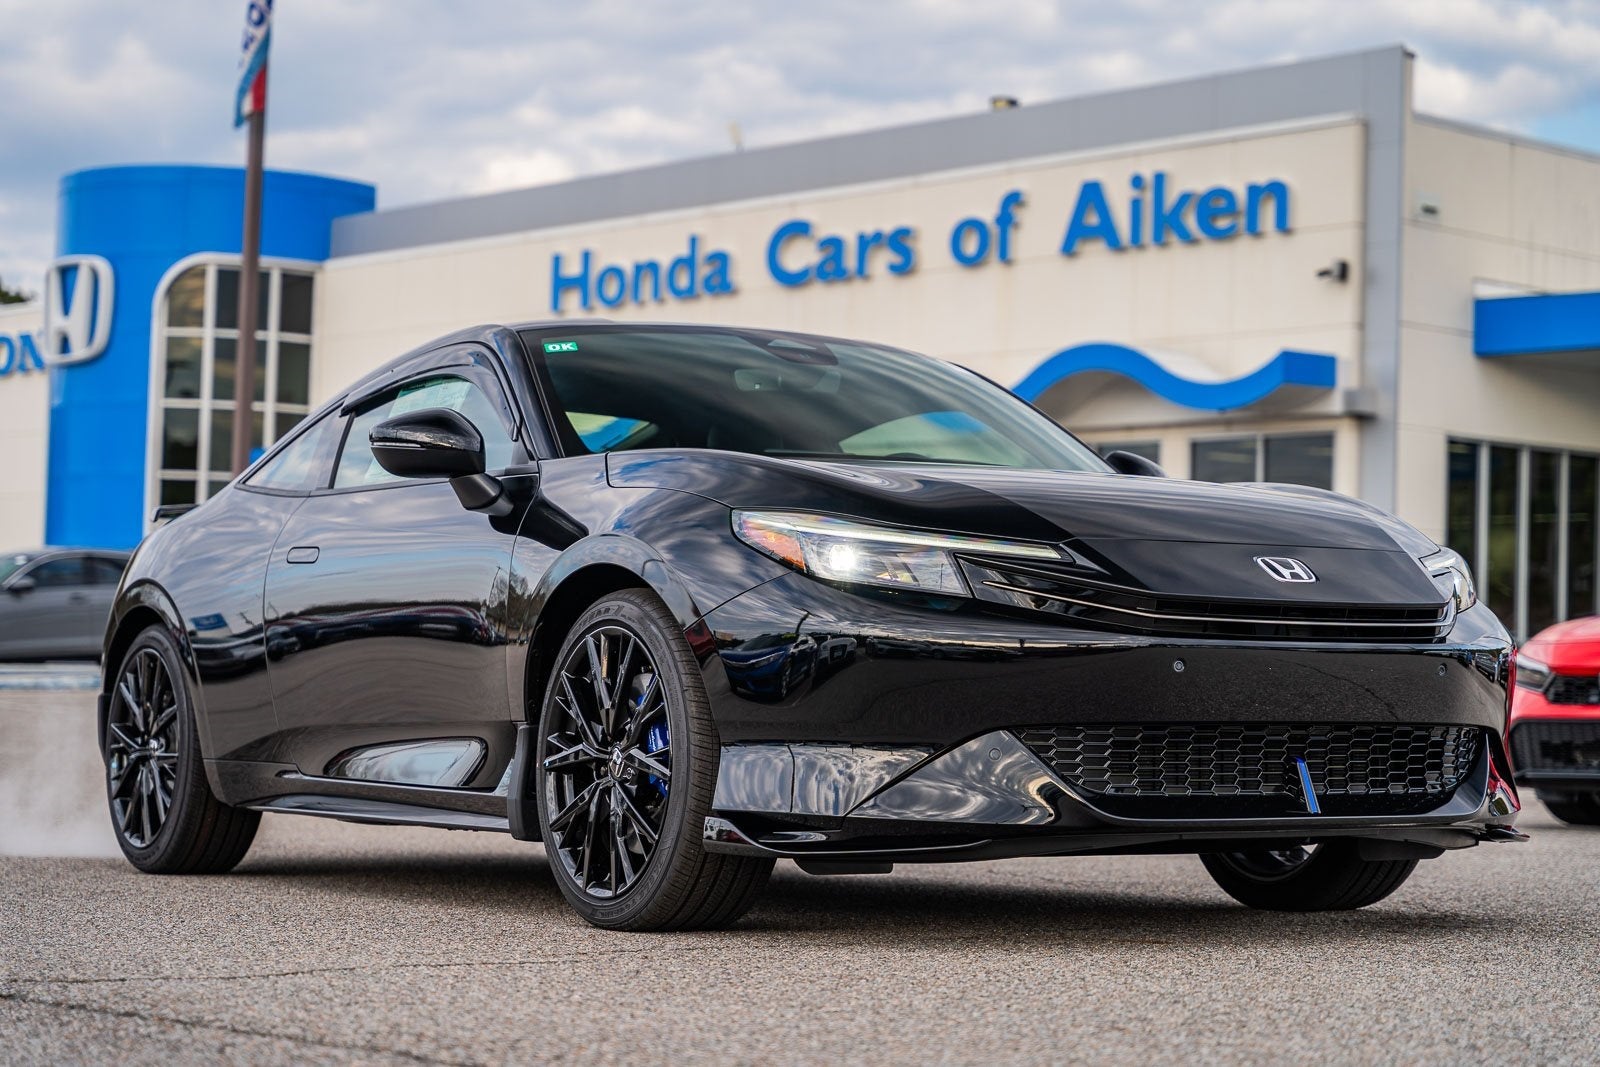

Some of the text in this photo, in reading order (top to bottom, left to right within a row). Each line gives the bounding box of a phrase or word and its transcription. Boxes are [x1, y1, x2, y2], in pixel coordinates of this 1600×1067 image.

[551, 172, 1289, 311] Honda Cars of Aiken
[547, 343, 576, 351] OK
